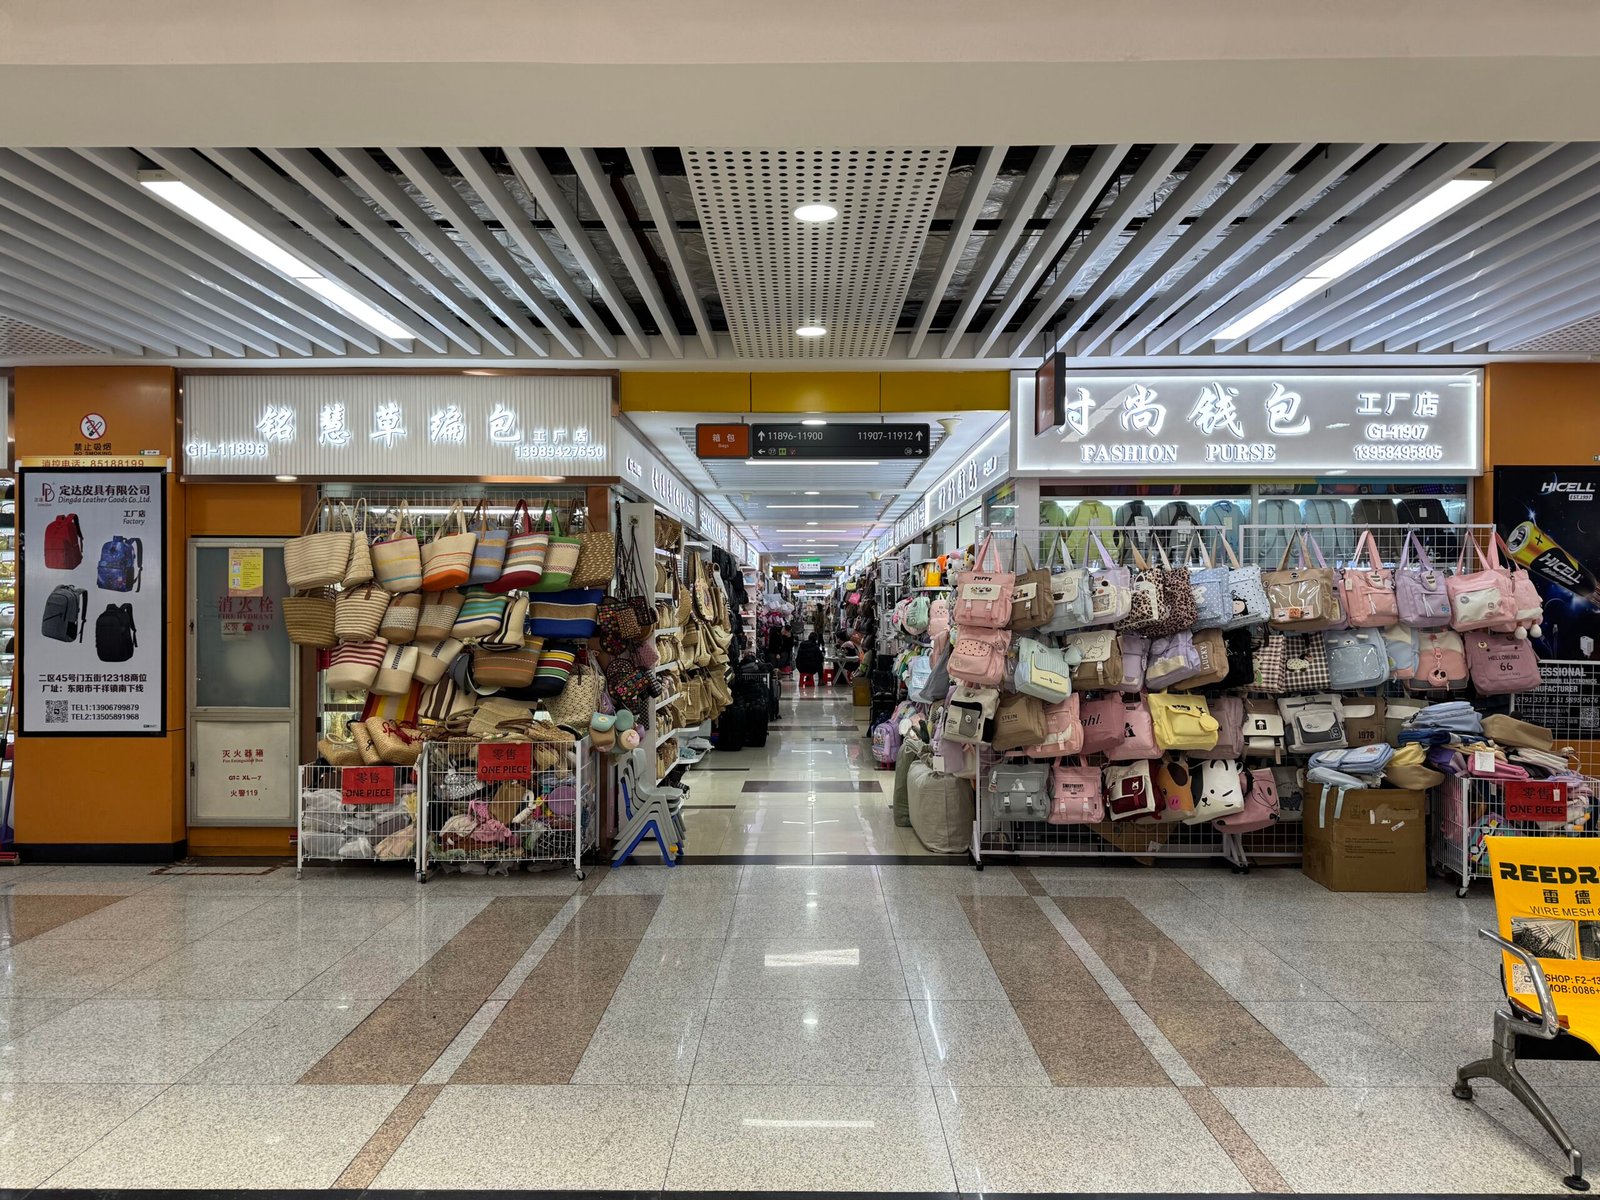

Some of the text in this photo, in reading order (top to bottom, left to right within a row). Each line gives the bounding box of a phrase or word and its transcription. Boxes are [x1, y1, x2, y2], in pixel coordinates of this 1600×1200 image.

[1356, 391, 1440, 415] 工厂店
[532, 428, 589, 444] 工厂店
[767, 431, 823, 441] 11896-11900
[858, 431, 913, 441] 11907-11912
[1366, 423, 1430, 440] G1-11907
[712, 433, 736, 442] 箱包
[74, 443, 112, 451] 禁止吸烟
[186, 442, 267, 457] G1-11896
[515, 446, 604, 459] 13989427650
[1080, 444, 1277, 463] FASHION PURSE
[1354, 445, 1443, 461] 13958495805
[60, 485, 150, 496] 定达皮具有限公司
[1541, 482, 1595, 492] HICELL
[58, 496, 82, 504] Dingda
[123, 510, 146, 518] 工厂店
[218, 596, 274, 612] 消火栓
[1500, 662, 1513, 671] 66
[1537, 667, 1586, 676] ESSIONAL
[39, 674, 147, 682] 二区45号门五街12318商位
[222, 749, 264, 758] 灭火器箱
[230, 789, 259, 797] 火警119
[345, 789, 391, 797] ONE PIECE
[1510, 805, 1564, 814] ONE PIECE
[1499, 861, 1600, 884] REEDR
[1543, 889, 1591, 904] 雷德
[1529, 905, 1595, 917] WIRE MESH
[1545, 974, 1574, 984] SHOP:
